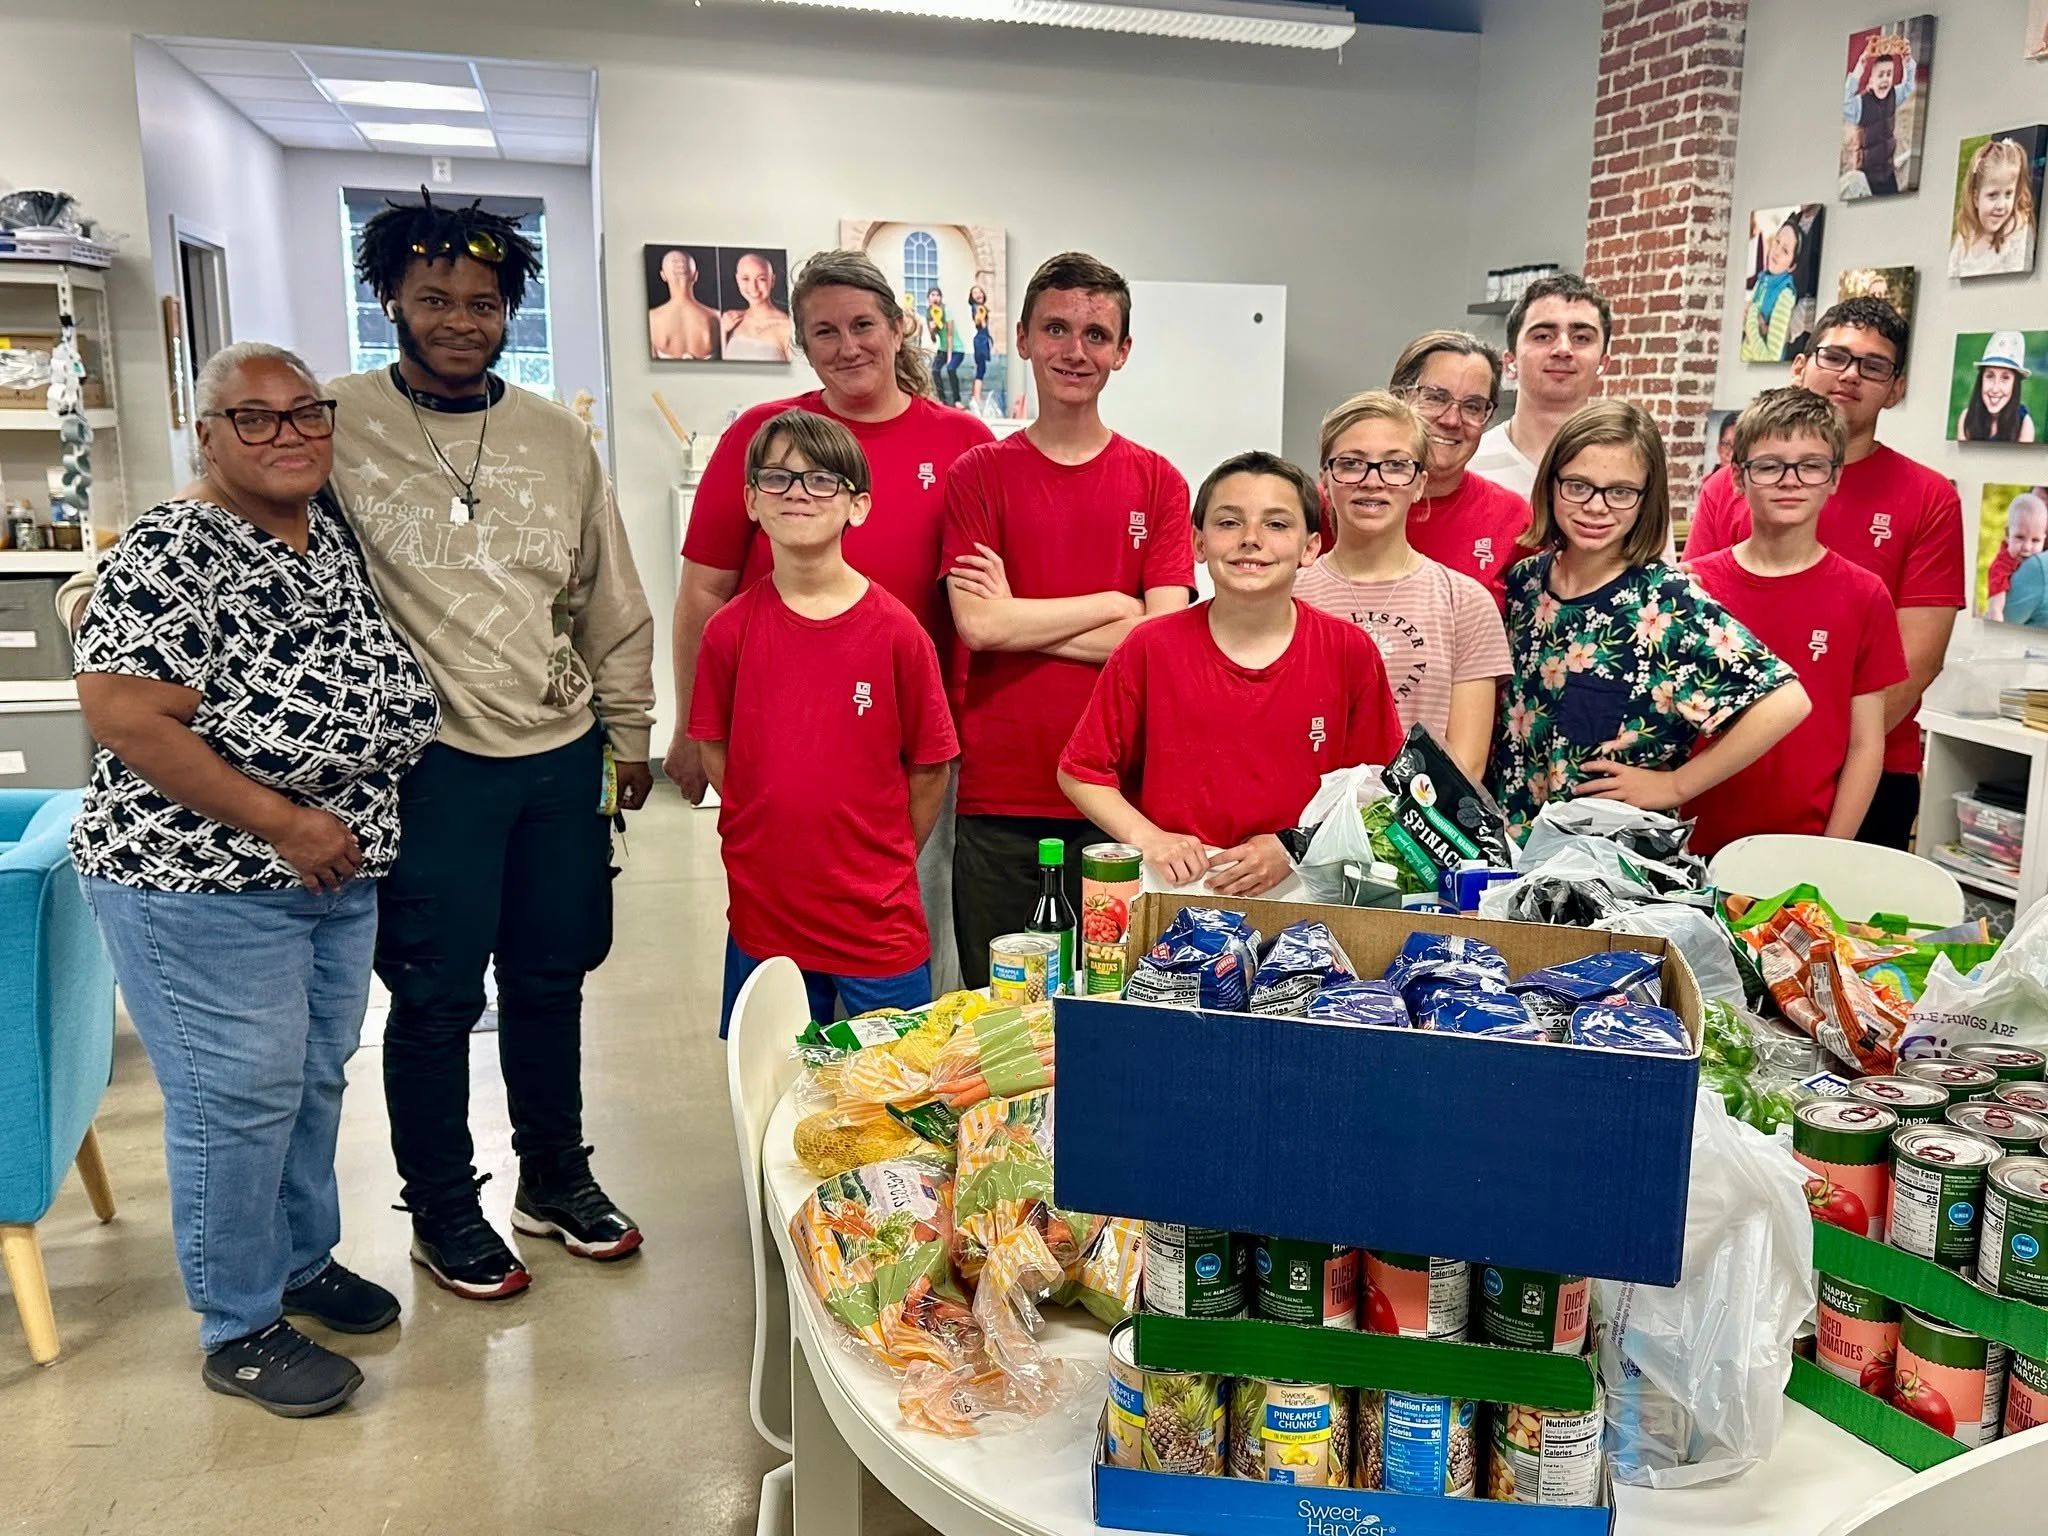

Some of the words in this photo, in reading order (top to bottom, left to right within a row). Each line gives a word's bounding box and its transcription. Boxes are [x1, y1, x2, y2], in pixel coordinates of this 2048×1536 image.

[353, 494, 435, 520] Morgan
[1351, 611, 1424, 648] LISTER
[1394, 661, 1427, 704] NIA
[1403, 809, 1461, 870] SPINAC
[1426, 807, 1459, 838] THOROUGHLY
[1456, 837, 1480, 859] WASHED
[1129, 989, 1159, 1000] Calories
[1174, 990, 1196, 998] 200
[1553, 1019, 1568, 1028] 20
[1989, 1022, 2018, 1038] ARE
[1897, 1117, 1930, 1126] HAPPY
[1920, 1169, 1941, 1181] Facts
[1926, 1194, 1938, 1205] 25
[1165, 1223, 1185, 1233] Facts
[1995, 1219, 2003, 1230] 25
[1172, 1248, 1184, 1259] 25
[1332, 1263, 1352, 1287] DICE
[1430, 1268, 1457, 1278] Calories
[2027, 1272, 2040, 1280] ALDI
[1276, 1293, 1303, 1303] DIFFERENCE
[1823, 1282, 1853, 1302] HAPPY
[1564, 1289, 1585, 1312] DICE
[1822, 1289, 1862, 1314] HARVEST
[1505, 1317, 1535, 1328] DIFFERENCE
[1563, 1308, 1585, 1331] TOM
[1821, 1311, 1842, 1338] DICED
[1820, 1327, 1863, 1361] TOMATOES
[2014, 1352, 2046, 1378] HAPPY
[1281, 1390, 1306, 1399] Sweet
[2009, 1383, 2033, 1414] DICED
[1390, 1397, 1420, 1411] Nutrition
[1422, 1403, 1441, 1412] Facts
[1274, 1410, 1322, 1420] PINEAPPLE
[1545, 1418, 1581, 1428] Nutrition
[1583, 1413, 1599, 1424] Facts
[1278, 1420, 1317, 1429] CHUNKS
[1389, 1425, 1412, 1437] Calories
[1431, 1429, 1441, 1438] 90
[1298, 1499, 1362, 1522] Sweet
